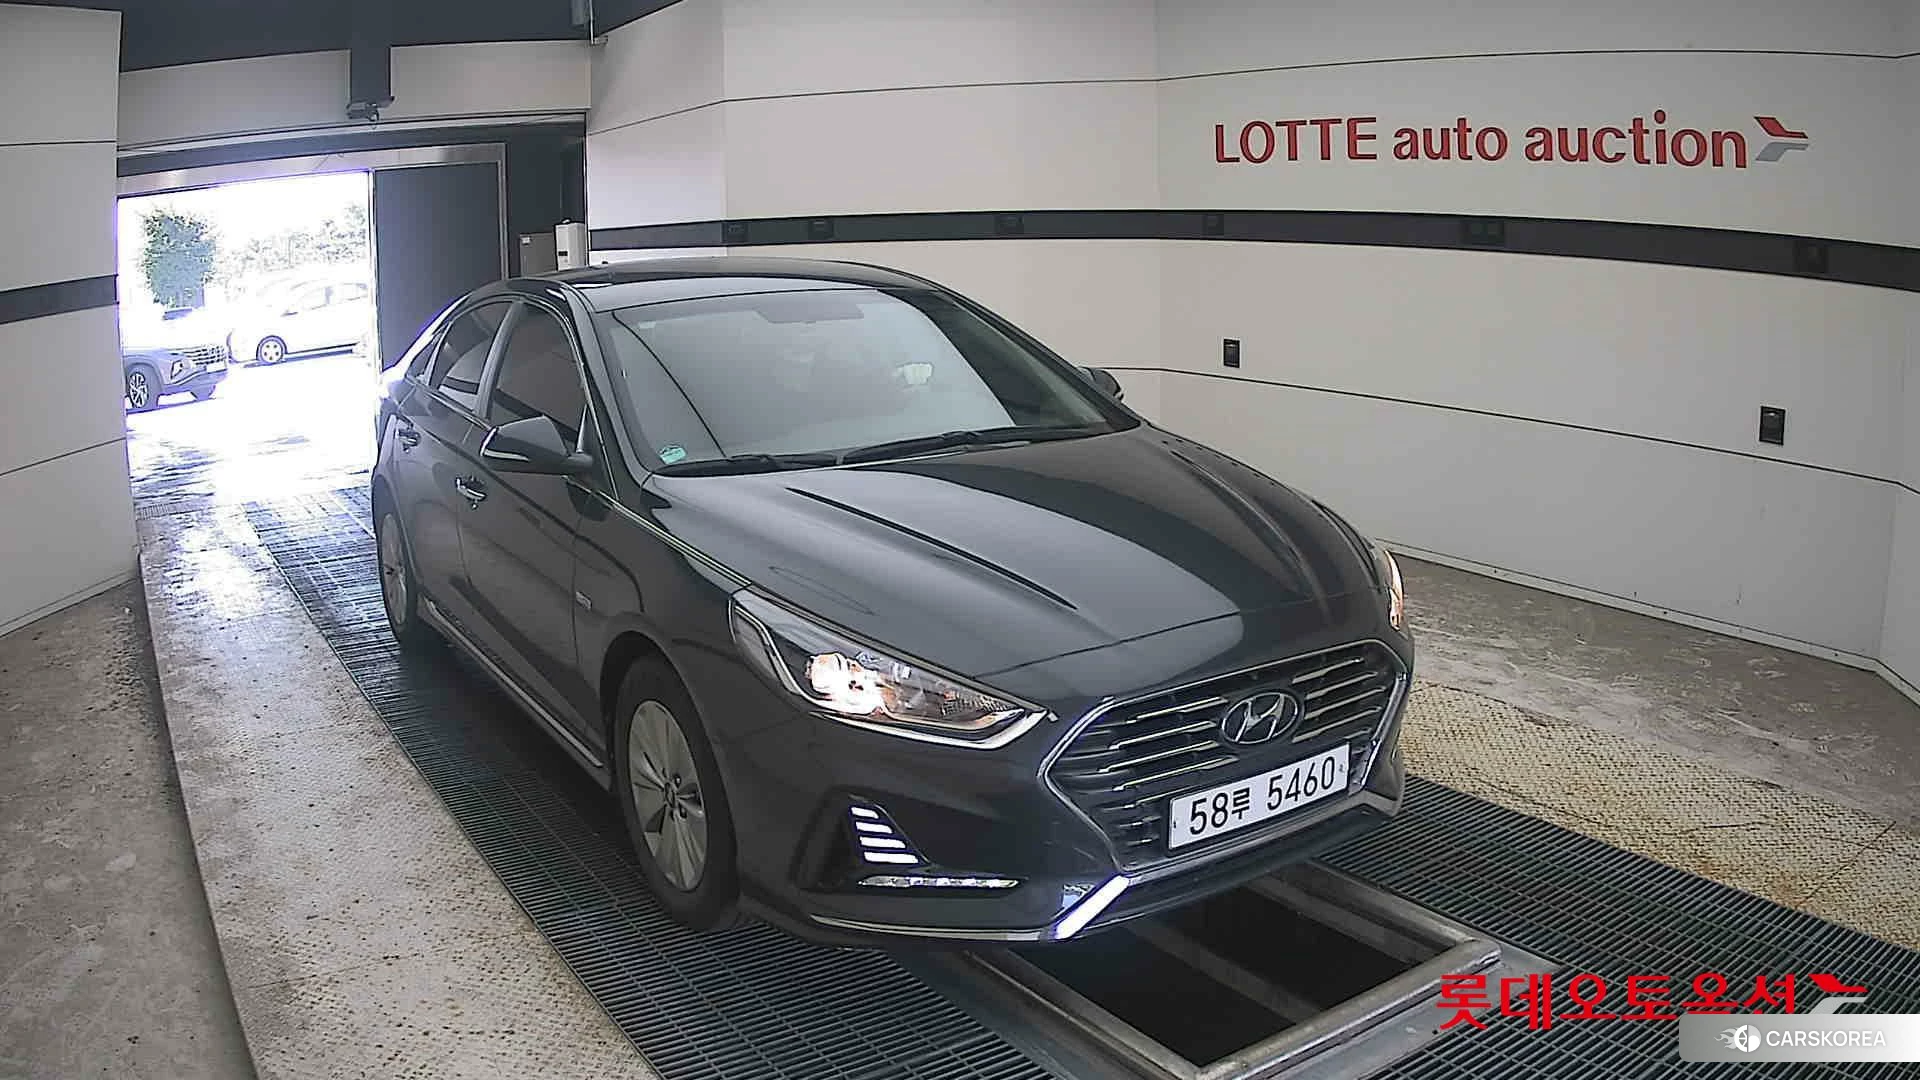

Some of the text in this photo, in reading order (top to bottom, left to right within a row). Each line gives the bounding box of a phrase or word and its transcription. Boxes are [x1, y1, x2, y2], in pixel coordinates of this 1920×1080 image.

[1216, 110, 1748, 168] LOTTE auto auction
[1189, 756, 1335, 835] 58루 5460
